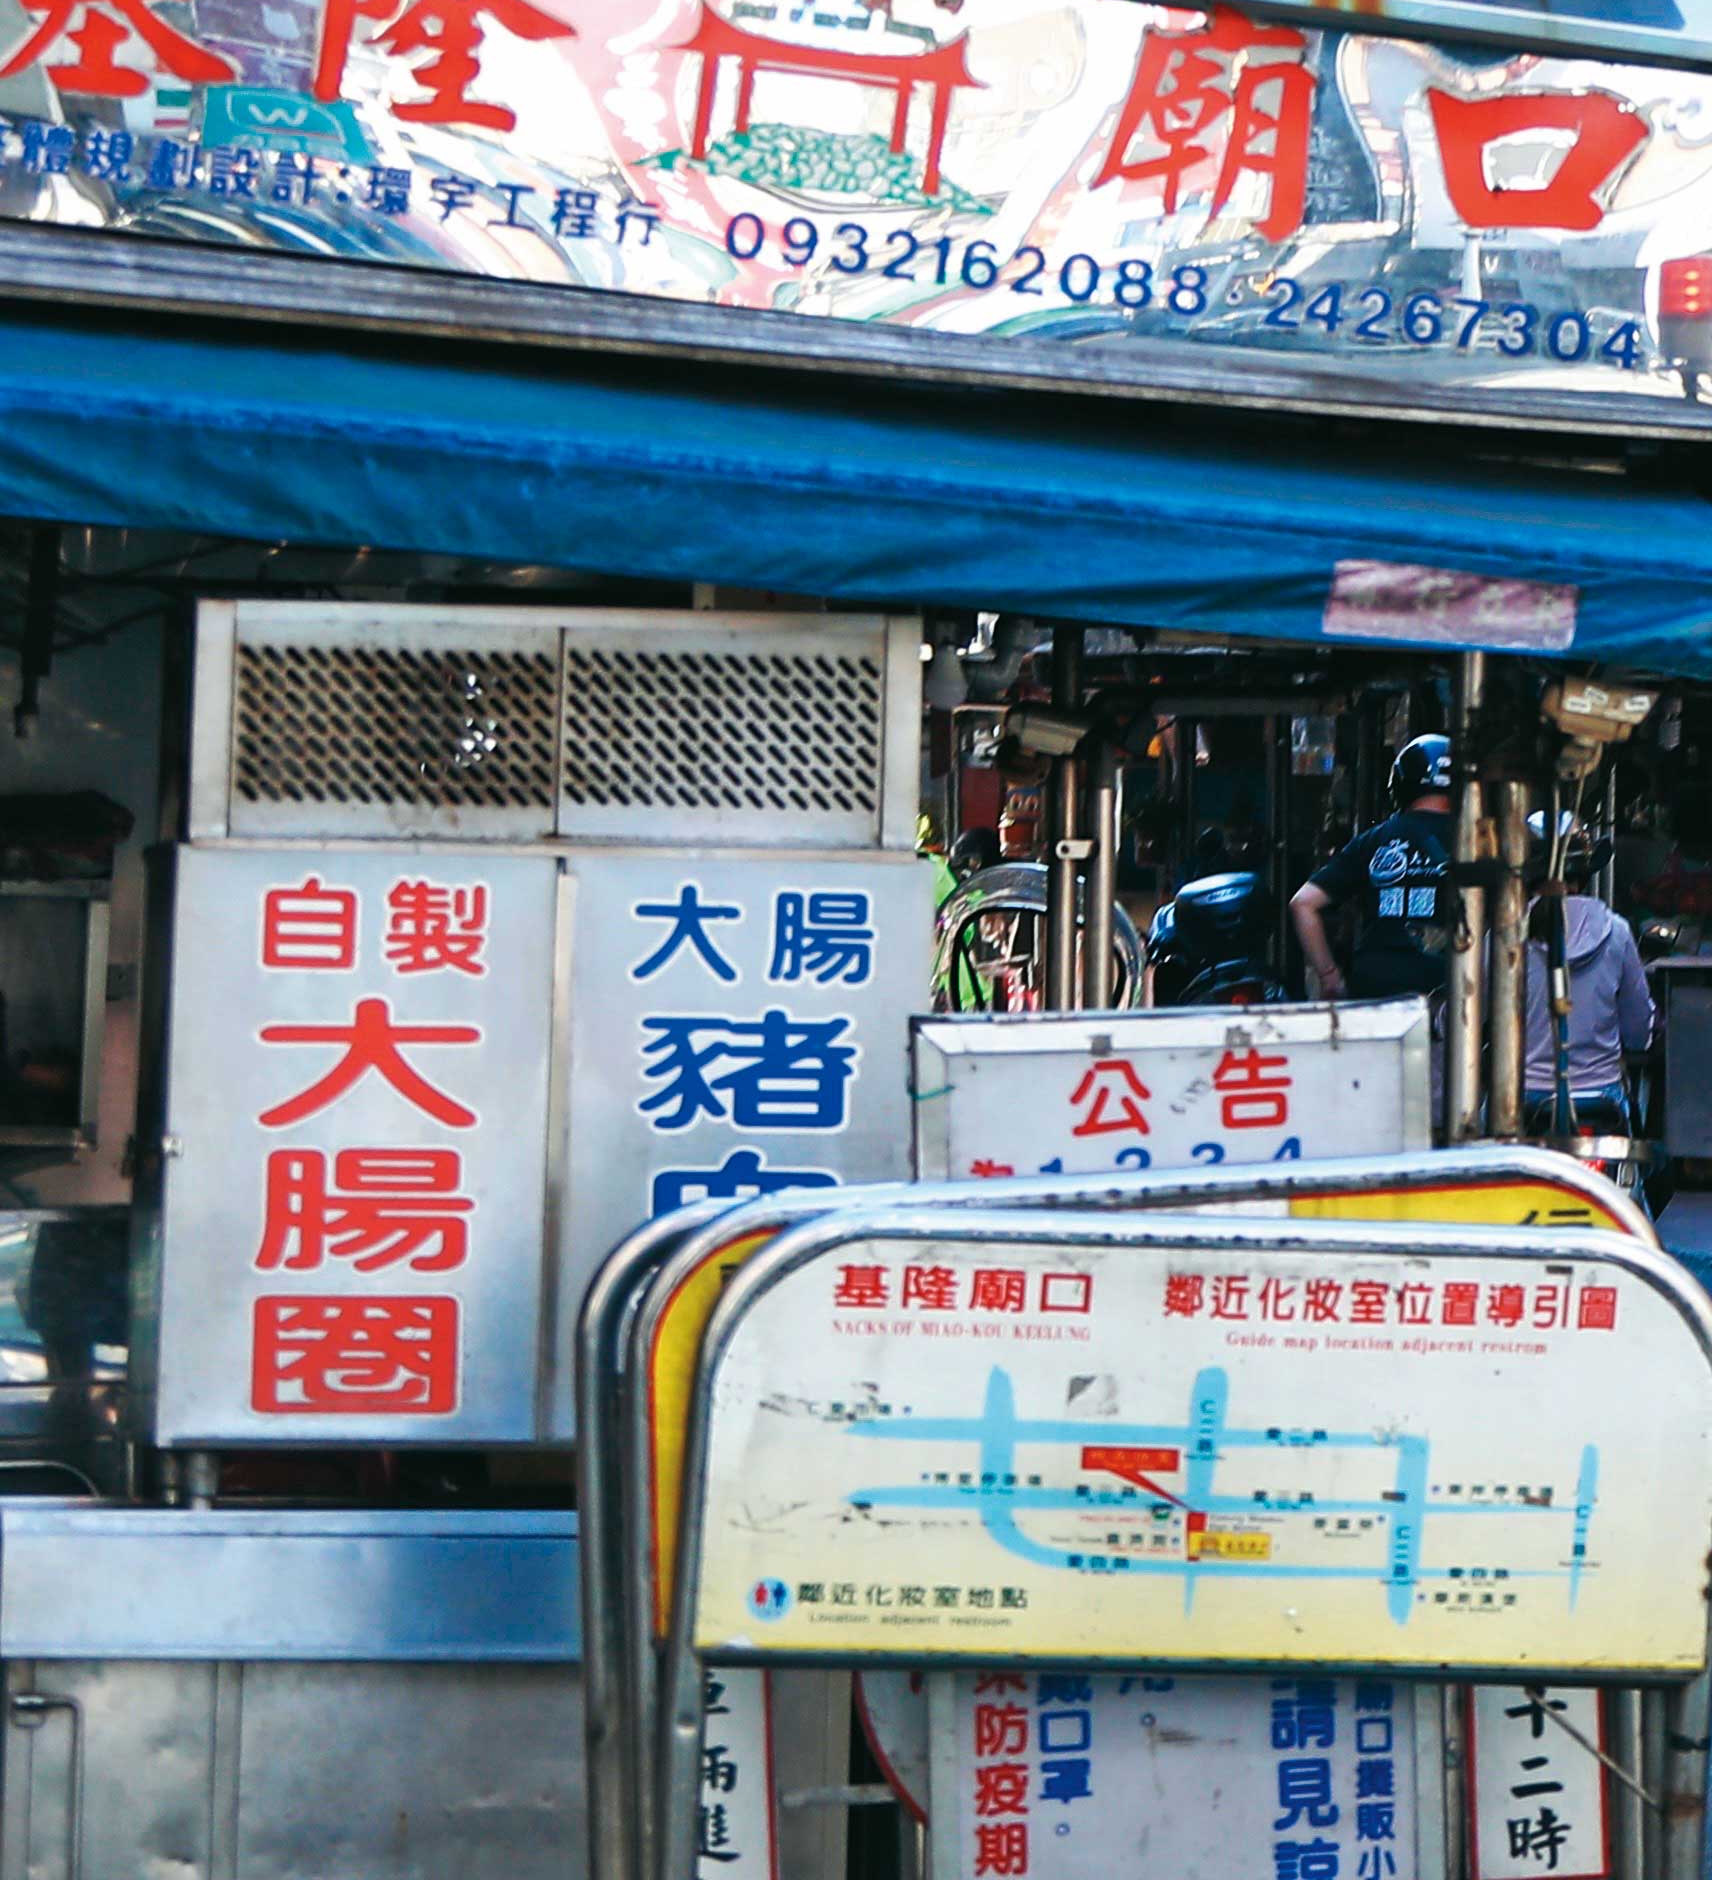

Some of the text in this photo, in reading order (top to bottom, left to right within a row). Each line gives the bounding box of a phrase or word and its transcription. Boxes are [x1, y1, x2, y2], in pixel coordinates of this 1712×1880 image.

[724, 211, 1643, 370] 0932162088 24267304
[260, 877, 489, 979] 自製
[631, 883, 879, 986] 大腸
[1069, 1047, 1293, 1138] 公告
[251, 996, 481, 1418] 大腸圈
[833, 1263, 1094, 1316] 基隆廟口
